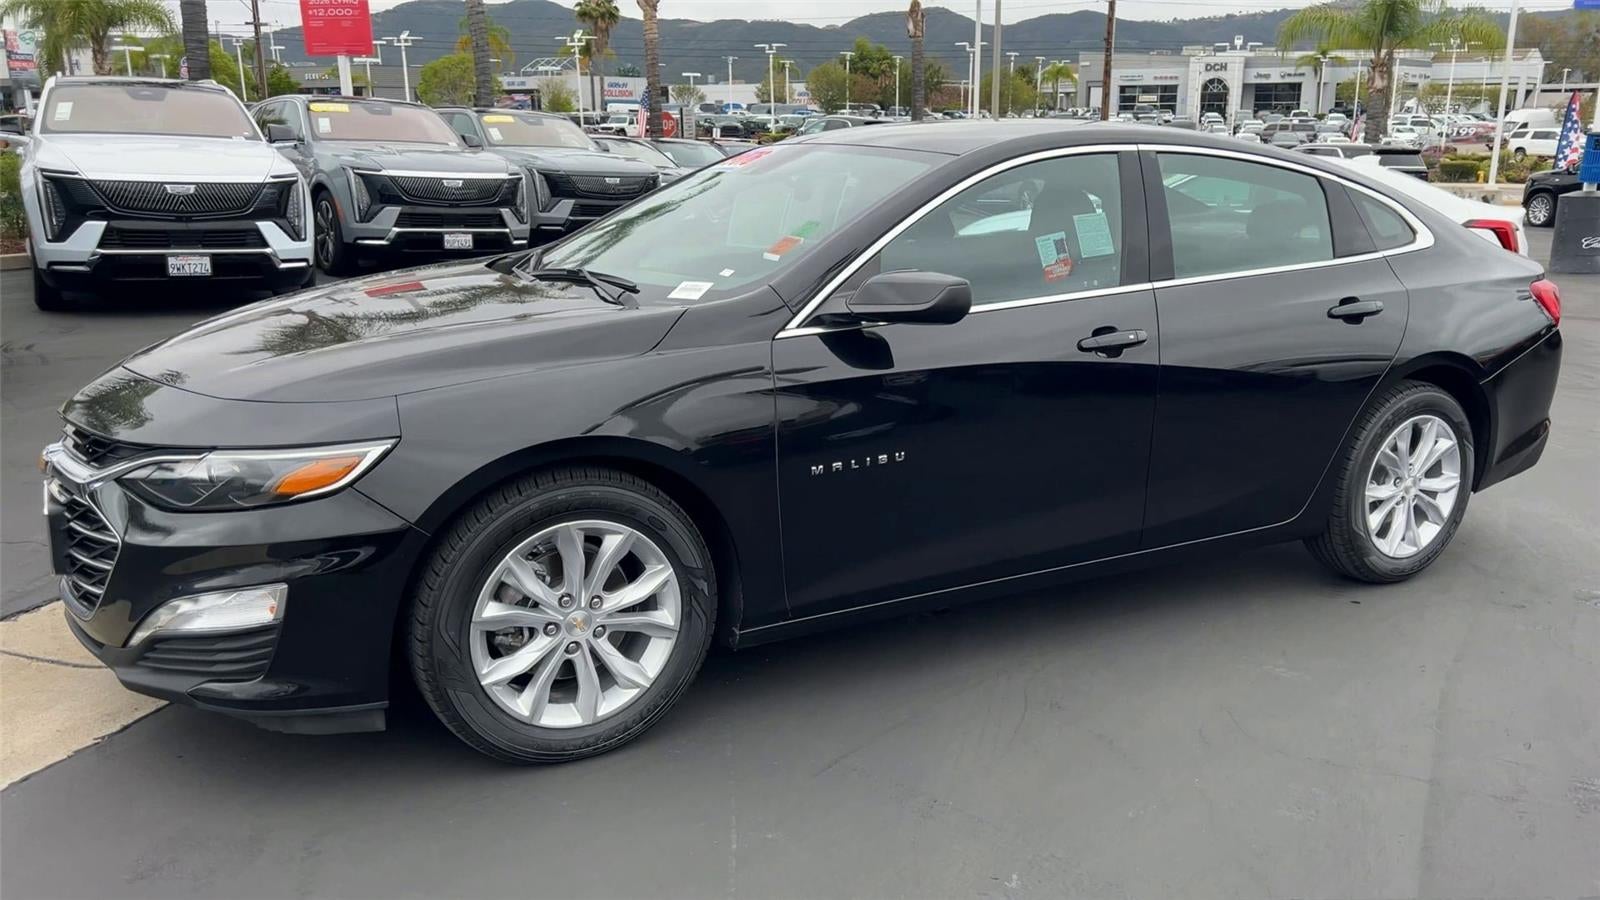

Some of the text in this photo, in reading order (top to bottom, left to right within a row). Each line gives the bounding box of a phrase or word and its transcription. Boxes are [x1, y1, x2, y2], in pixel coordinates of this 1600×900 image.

[1205, 62, 1228, 72] DCH
[662, 119, 674, 130] OP
[170, 263, 209, 273] 9WKT274
[811, 451, 905, 475] MALIBU
